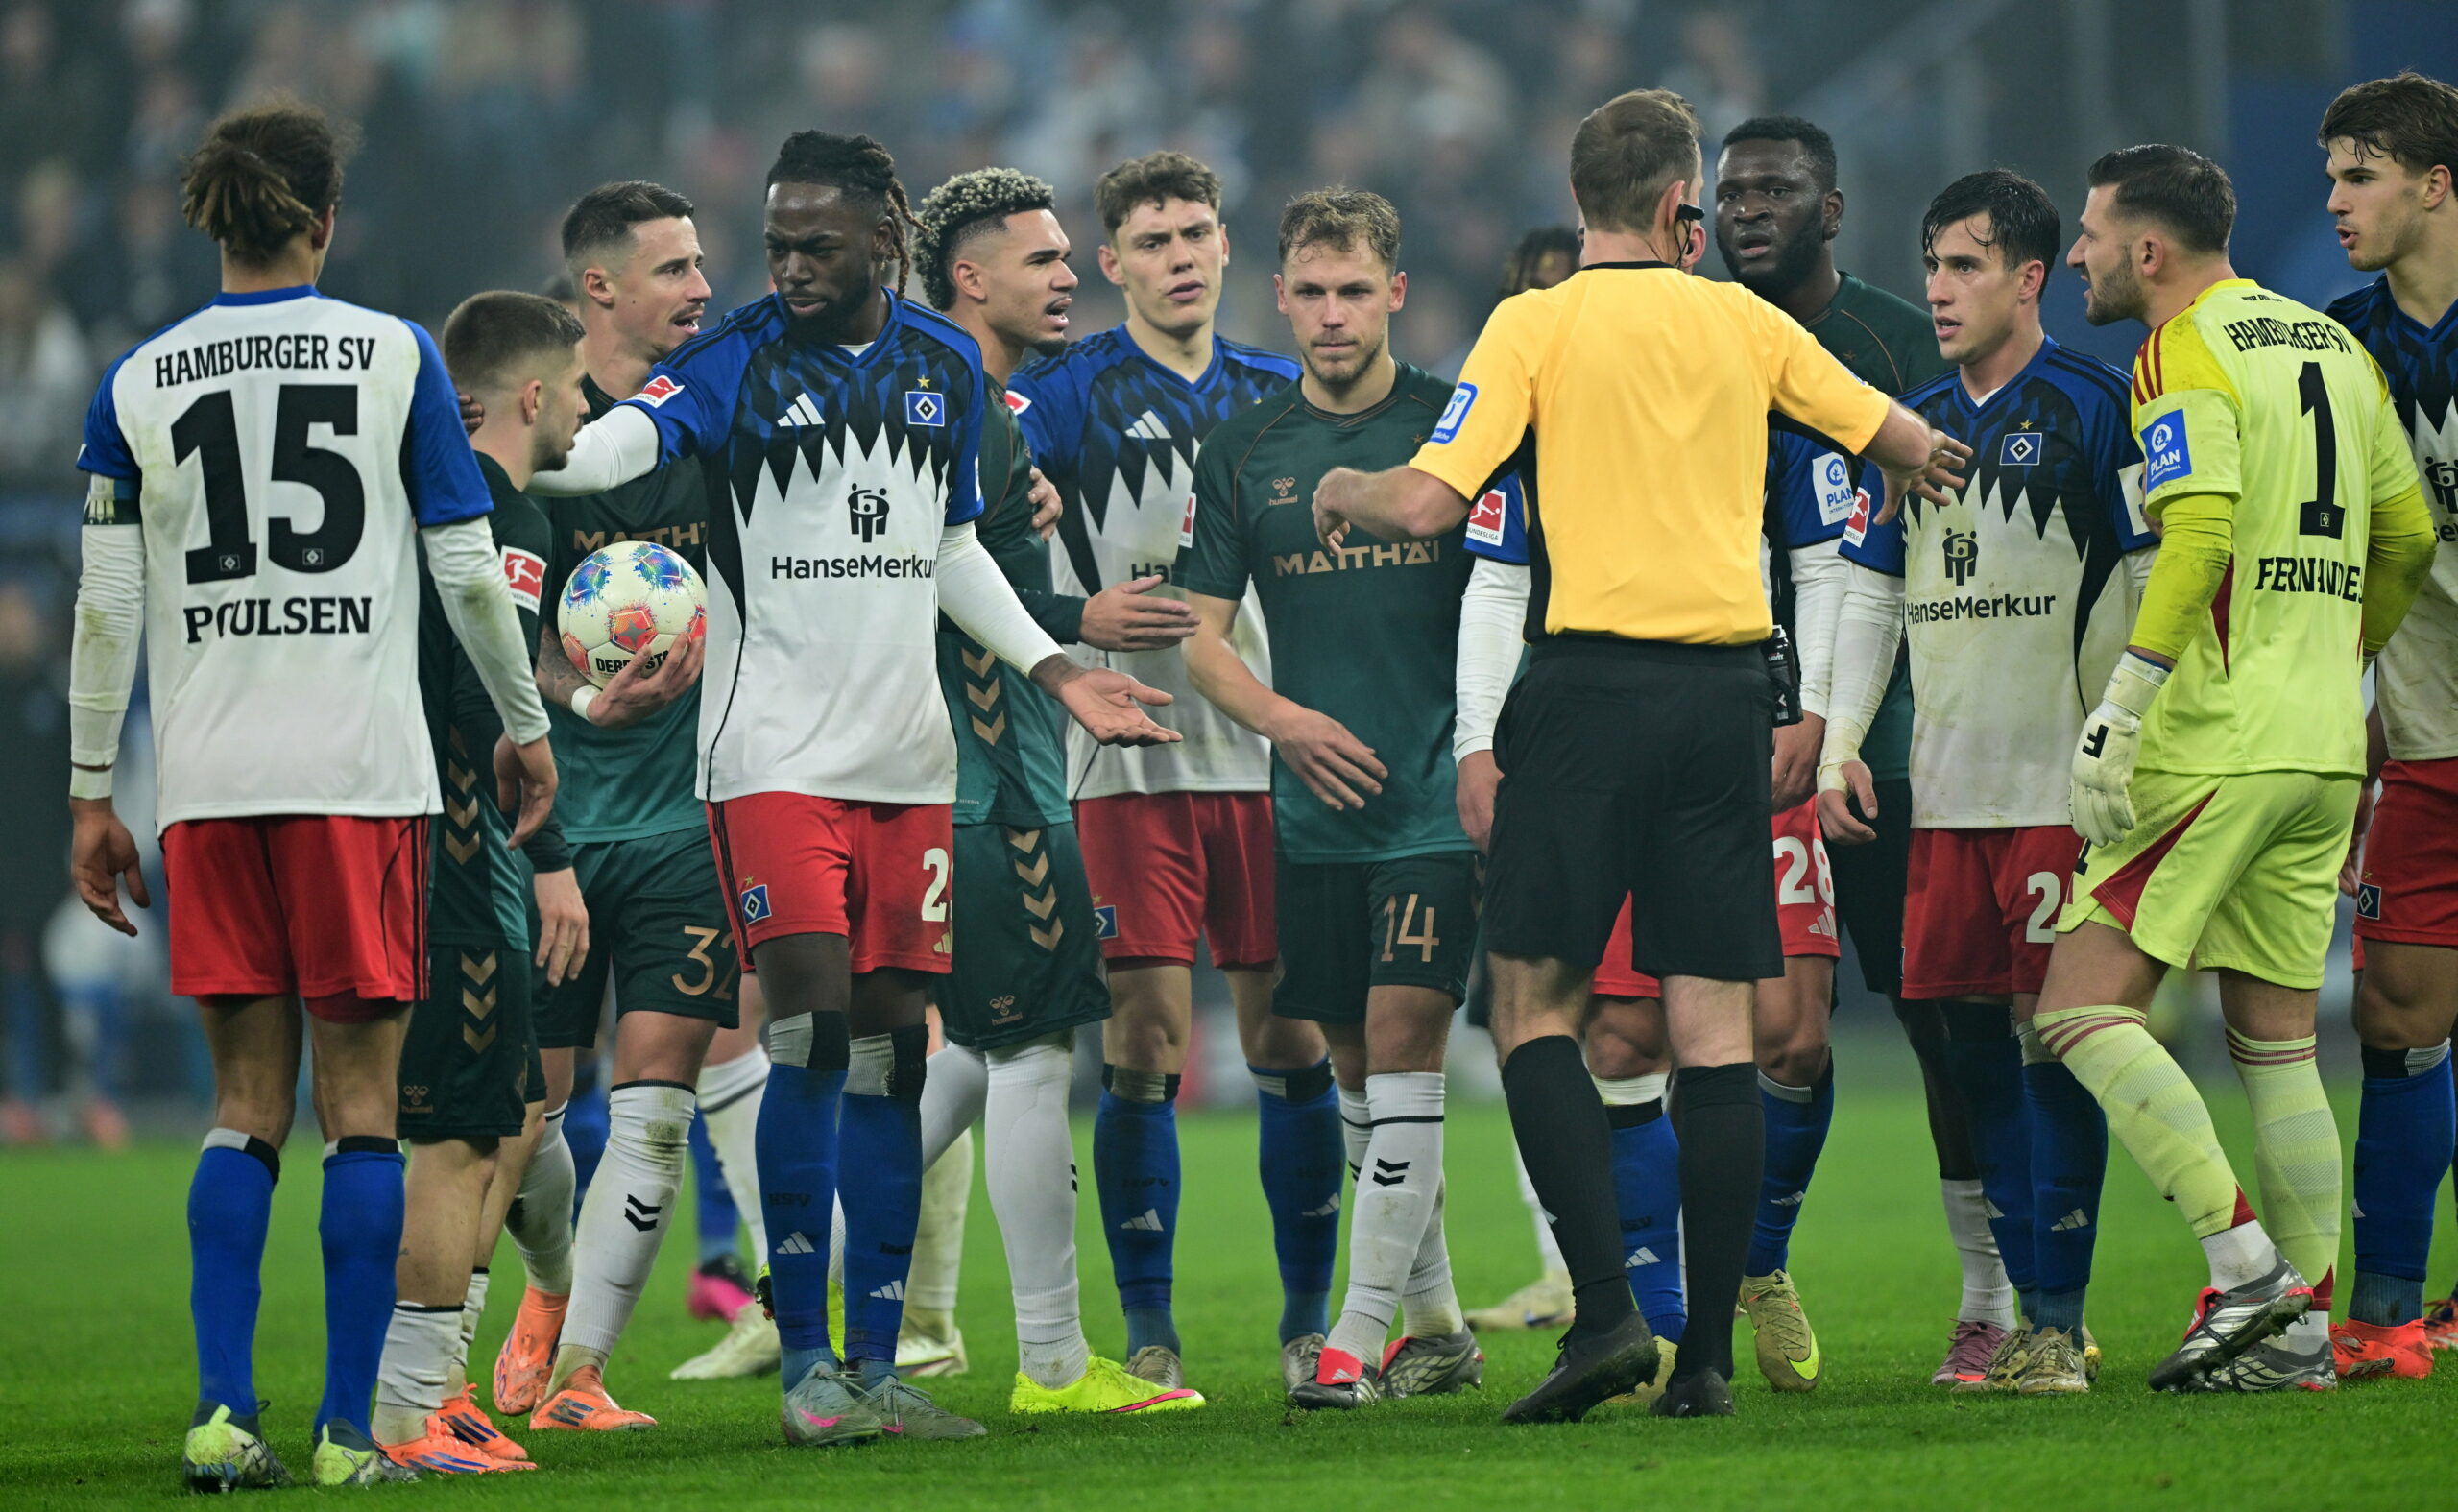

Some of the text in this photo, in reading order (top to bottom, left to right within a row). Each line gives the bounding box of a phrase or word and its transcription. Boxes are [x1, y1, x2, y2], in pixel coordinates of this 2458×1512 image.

[155, 334, 375, 388] HAMBURGER SV
[2151, 449, 2181, 476] PLAN
[2297, 361, 2346, 540] 1
[170, 384, 366, 586] 15
[1268, 494, 1298, 506] hummel
[1826, 488, 1853, 507] PLAN
[1829, 501, 1855, 515] INTERNATION
[772, 554, 936, 579] HanseMerku
[1906, 593, 2057, 625] HanseMerkur
[922, 848, 953, 922] 2
[1772, 836, 1835, 907] 28
[1381, 893, 1440, 963] 14
